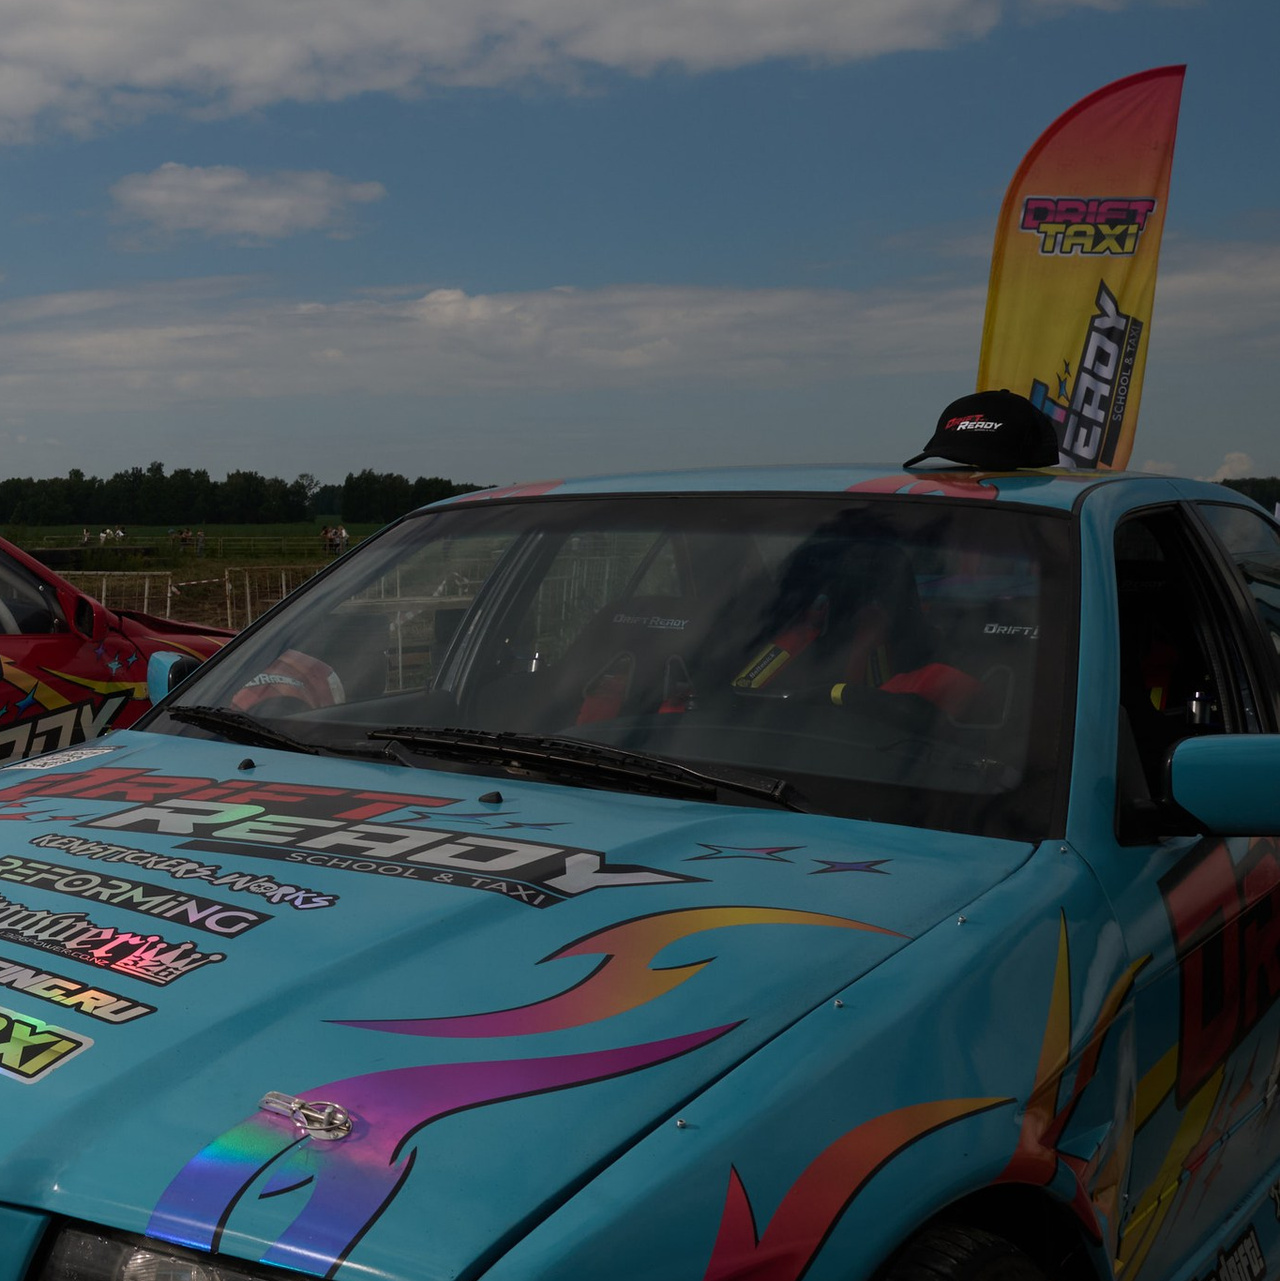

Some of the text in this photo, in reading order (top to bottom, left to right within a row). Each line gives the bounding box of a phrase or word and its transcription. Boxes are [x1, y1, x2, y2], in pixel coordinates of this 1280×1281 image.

[1021, 197, 1155, 231] DRIFT
[1037, 222, 1141, 254] TAXI
[1052, 285, 1128, 468] EADY
[1112, 324, 1142, 422] SCHOOL & TAXI
[956, 421, 1003, 431] READY
[613, 614, 689, 627] DRIFT READY
[84, 799, 687, 894] READY
[285, 852, 547, 906] SCHOOL & TAXI
